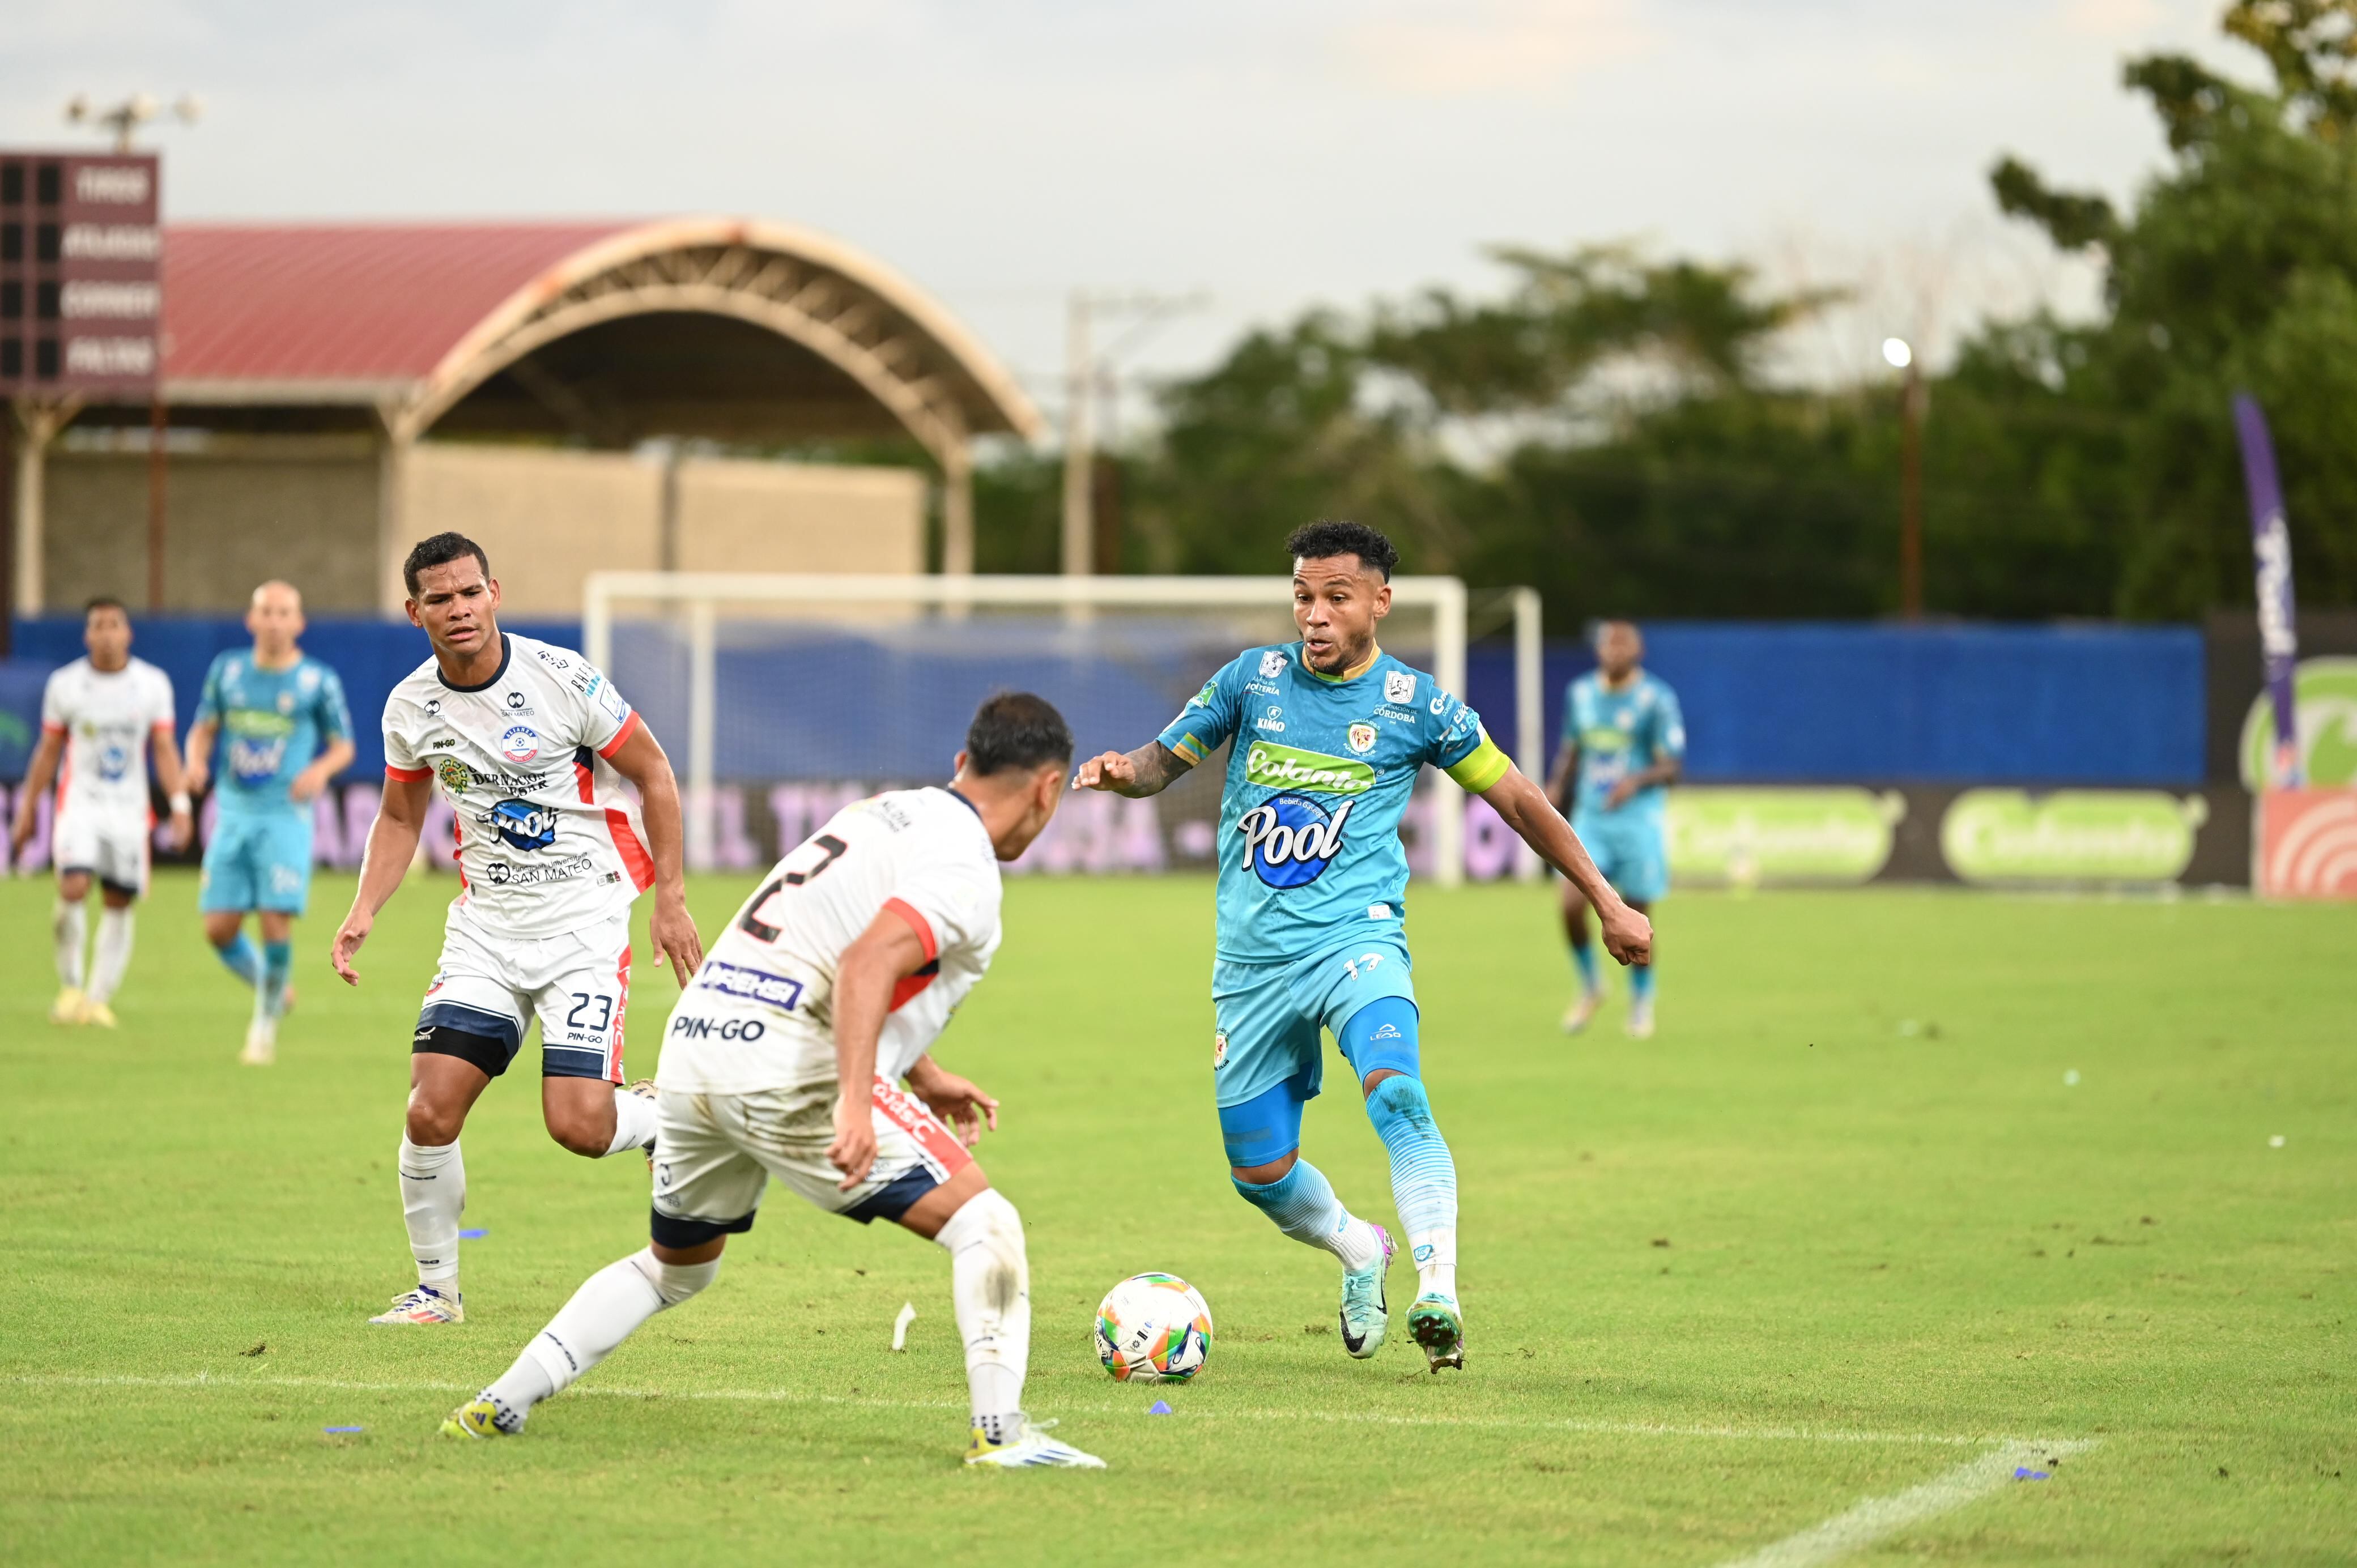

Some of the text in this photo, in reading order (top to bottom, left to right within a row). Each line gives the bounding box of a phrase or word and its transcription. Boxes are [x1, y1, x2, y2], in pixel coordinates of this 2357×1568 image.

[1257, 718, 1286, 732] KIMO
[1373, 708, 1415, 724] CÓRDOBA
[506, 727, 533, 739] ALIANZA
[433, 739, 455, 749] PIN-GO
[1237, 799, 1356, 872] Pool
[510, 859, 592, 884] SAN MATEO
[738, 834, 848, 944] 2
[1342, 953, 1384, 981] 17
[567, 992, 612, 1032] 23
[567, 1033, 602, 1043] PIN-GO
[672, 1017, 765, 1042] PIN-GO
[1219, 1059, 1229, 1070] CLUB
